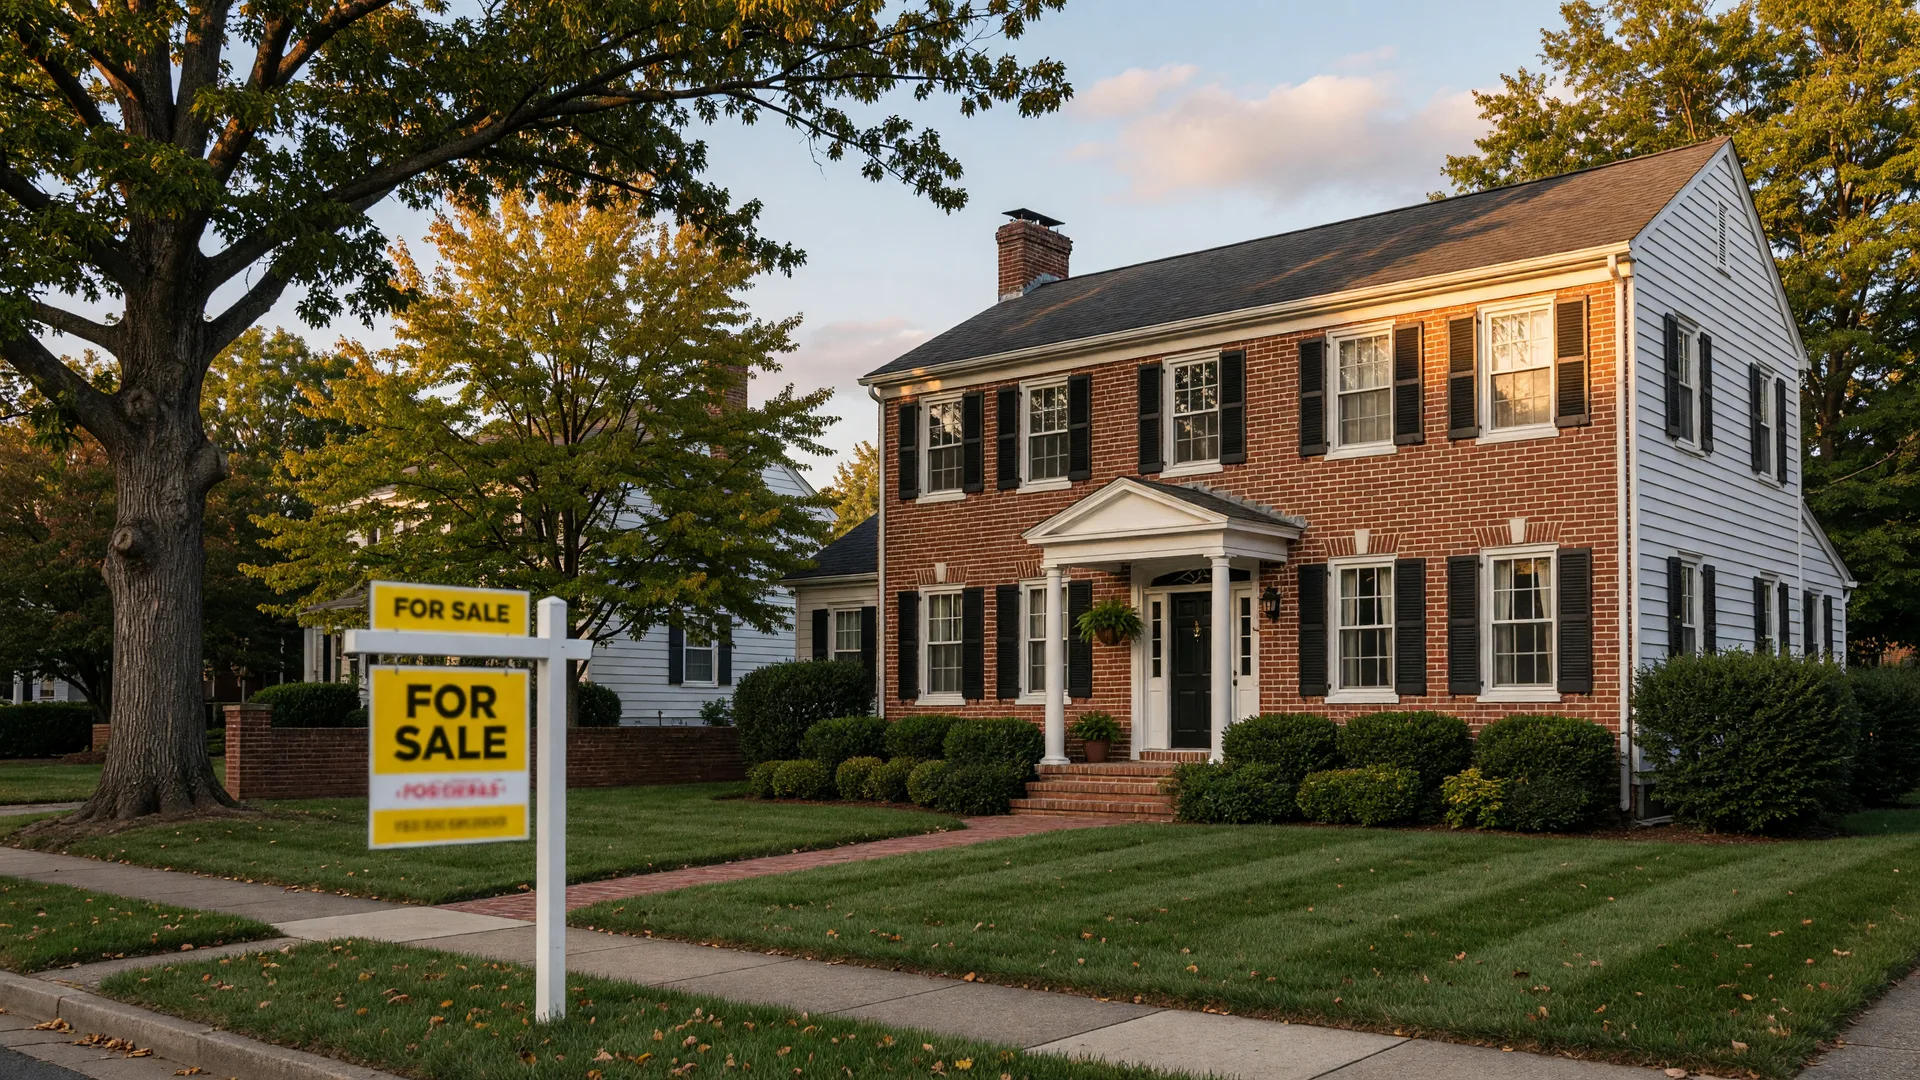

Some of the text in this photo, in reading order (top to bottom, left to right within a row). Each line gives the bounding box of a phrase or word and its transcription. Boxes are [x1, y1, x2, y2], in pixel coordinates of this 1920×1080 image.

[393, 596, 510, 624] FOR SALE
[405, 683, 498, 720] FOR
[393, 724, 508, 763] SALE
